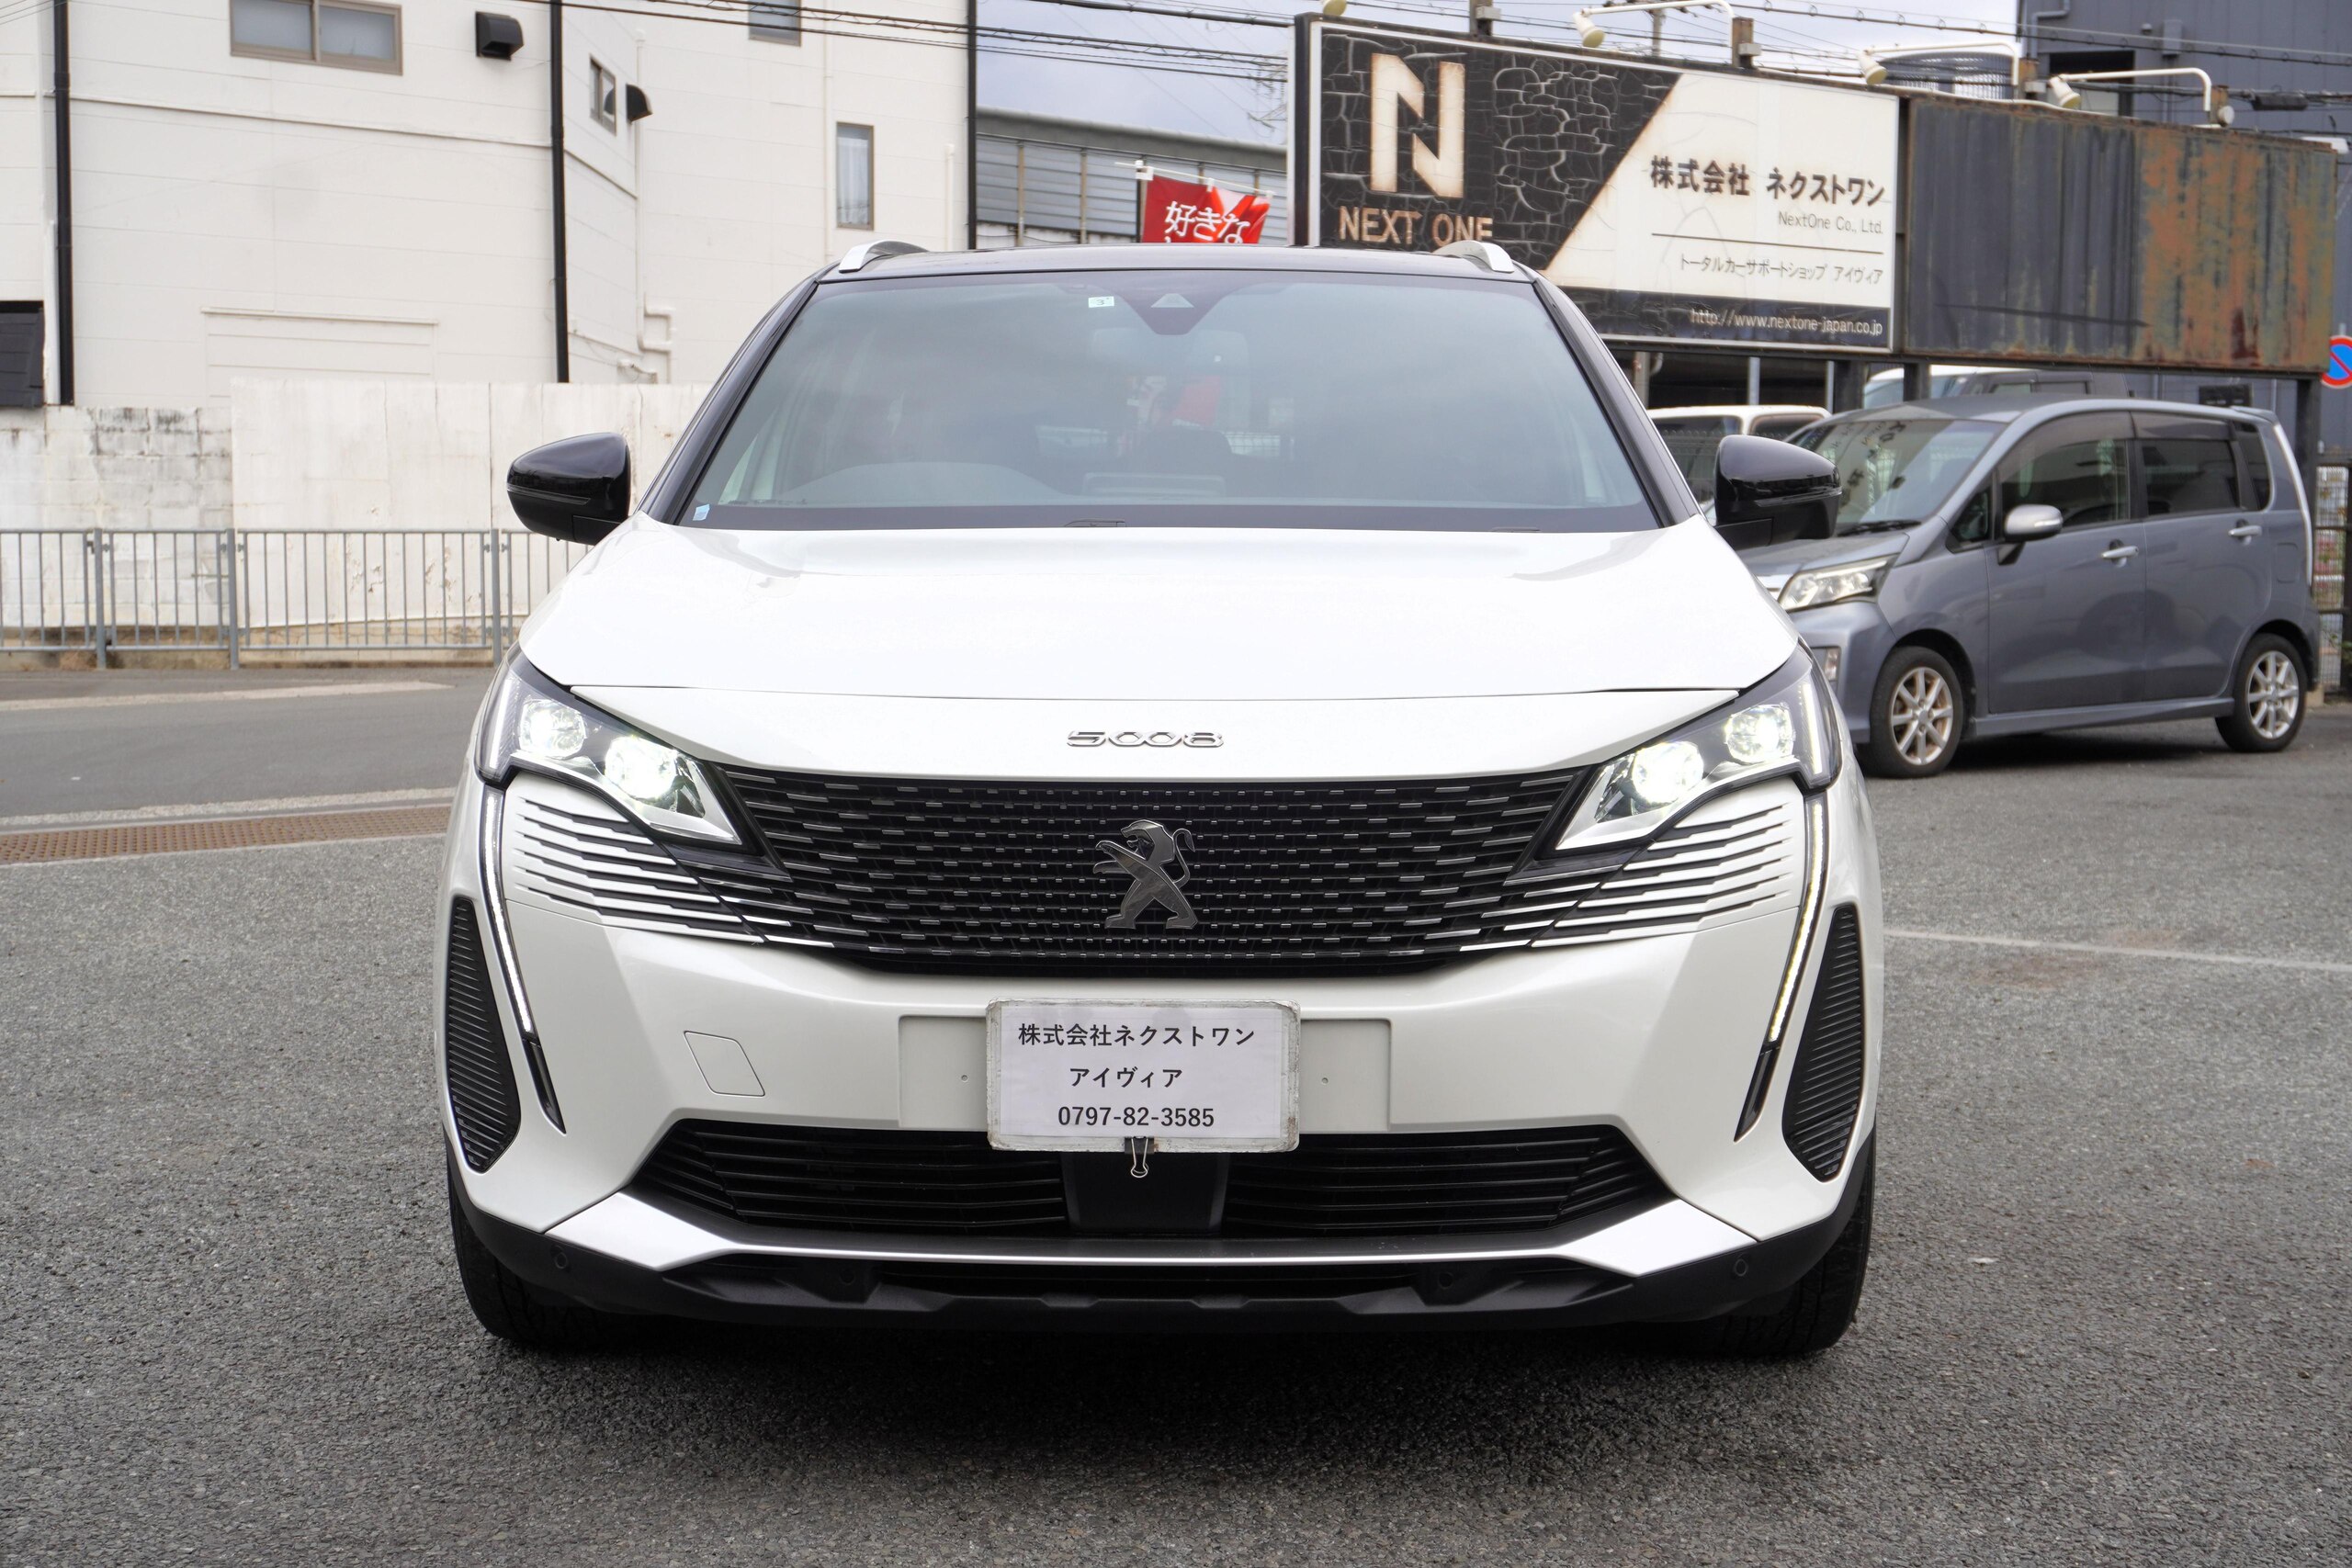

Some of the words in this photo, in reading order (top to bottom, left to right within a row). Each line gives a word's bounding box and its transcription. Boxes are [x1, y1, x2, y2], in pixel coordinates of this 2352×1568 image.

[1651, 155, 1750, 197] 株式会社
[1767, 167, 1885, 207] ネクストワン
[1164, 200, 1250, 243] 好きな
[1340, 206, 1423, 245] NEXT
[1779, 211, 1831, 230] NextOne
[1836, 216, 1857, 233] Co.,
[1861, 218, 1883, 235] Ltd.
[1680, 253, 1827, 281] トータルカーサポートショップ
[1833, 265, 1883, 286] アイヴィア
[1691, 308, 1883, 337] http://www.nextone-japan.co.jp
[1067, 731, 1225, 749] 5008
[1018, 1023, 1255, 1047] 株式会社ネクストワン
[1069, 1066, 1183, 1089] アイヴィア
[1057, 1106, 1215, 1127] 0797-82-3585
